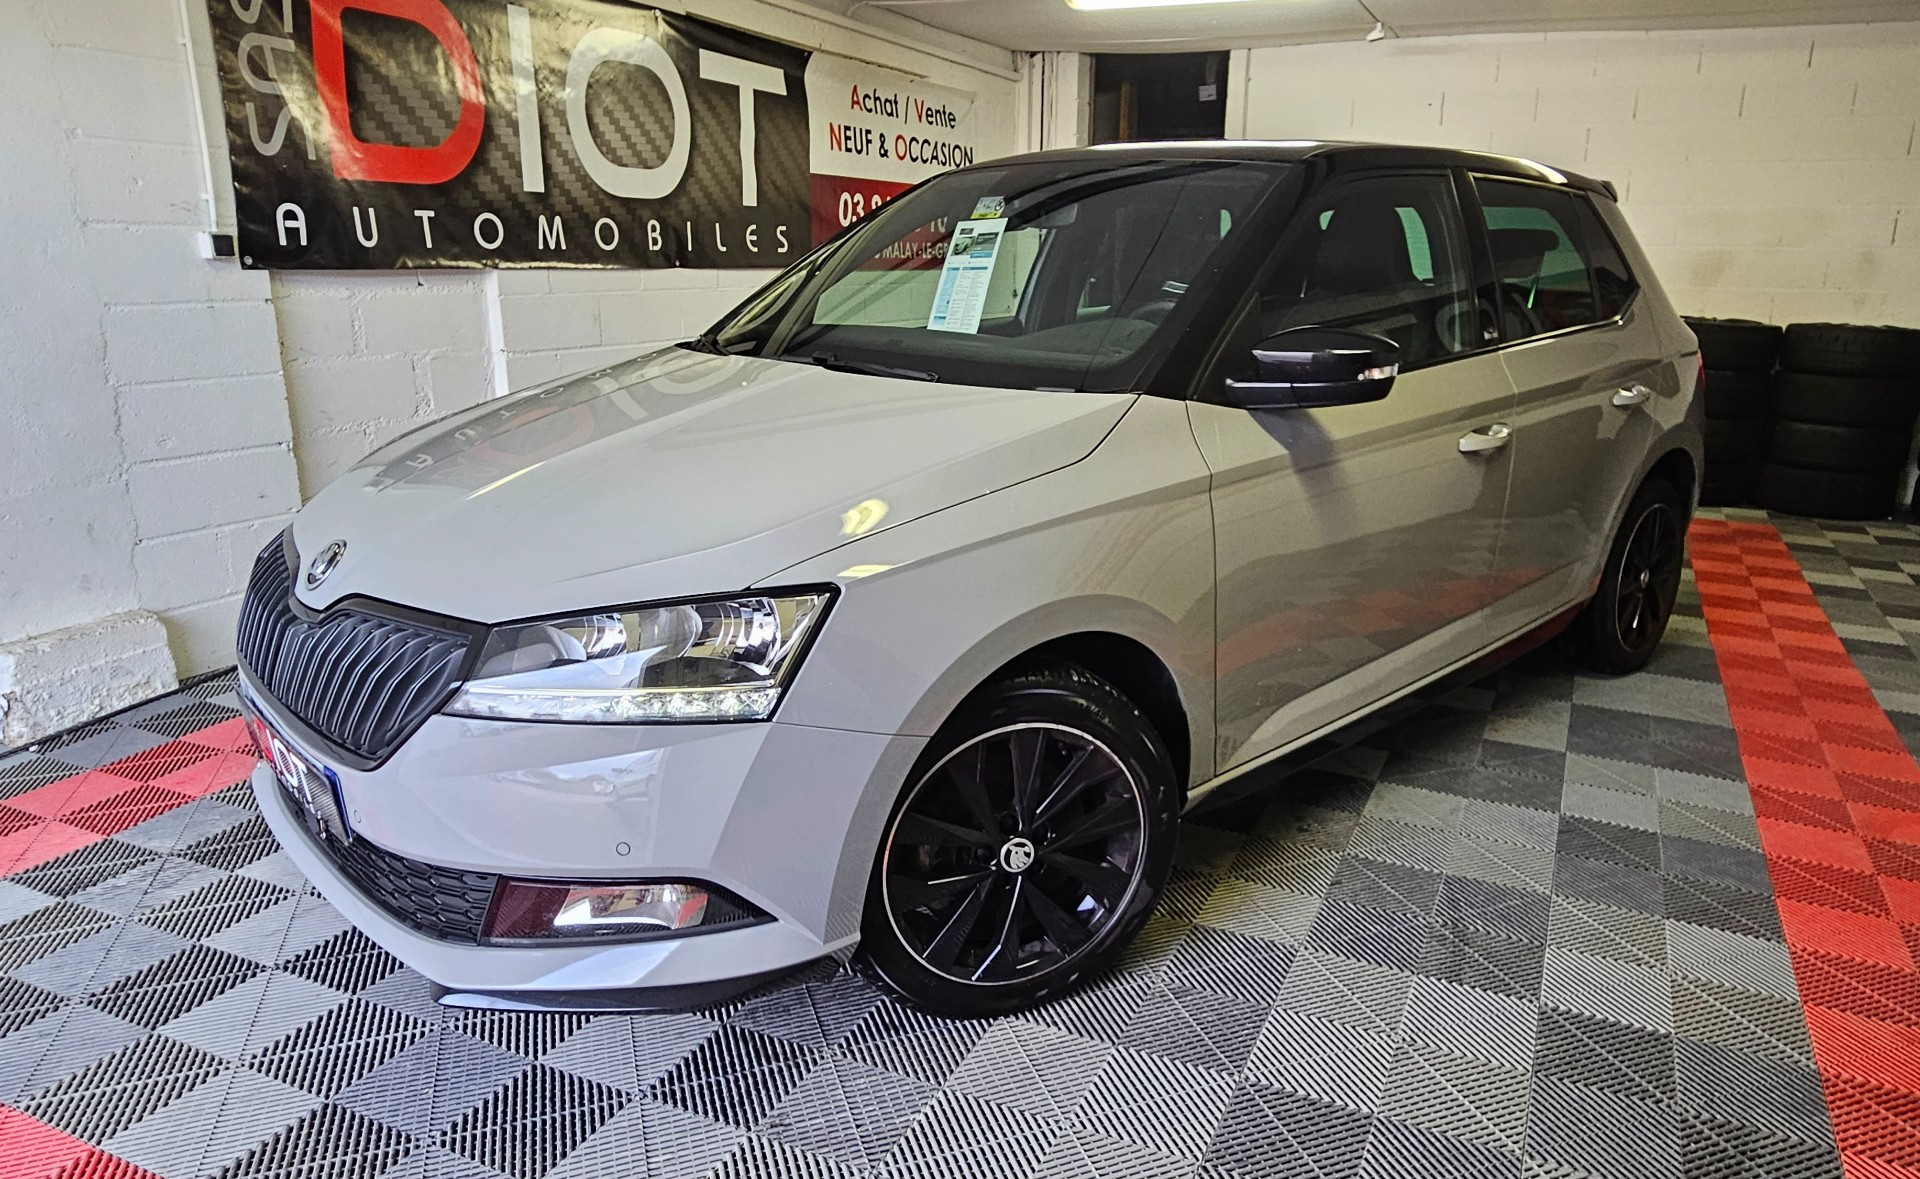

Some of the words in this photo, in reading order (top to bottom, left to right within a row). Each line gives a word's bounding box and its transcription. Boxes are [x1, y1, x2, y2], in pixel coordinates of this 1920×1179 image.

[310, 0, 788, 207] DIOT
[851, 85, 899, 119] Achat
[903, 95, 911, 124] /
[913, 97, 957, 129] Vente
[829, 122, 873, 156] NEUF
[878, 132, 889, 159] &
[895, 134, 973, 168] OCCASION
[275, 201, 790, 254] AUTOMOBILES
